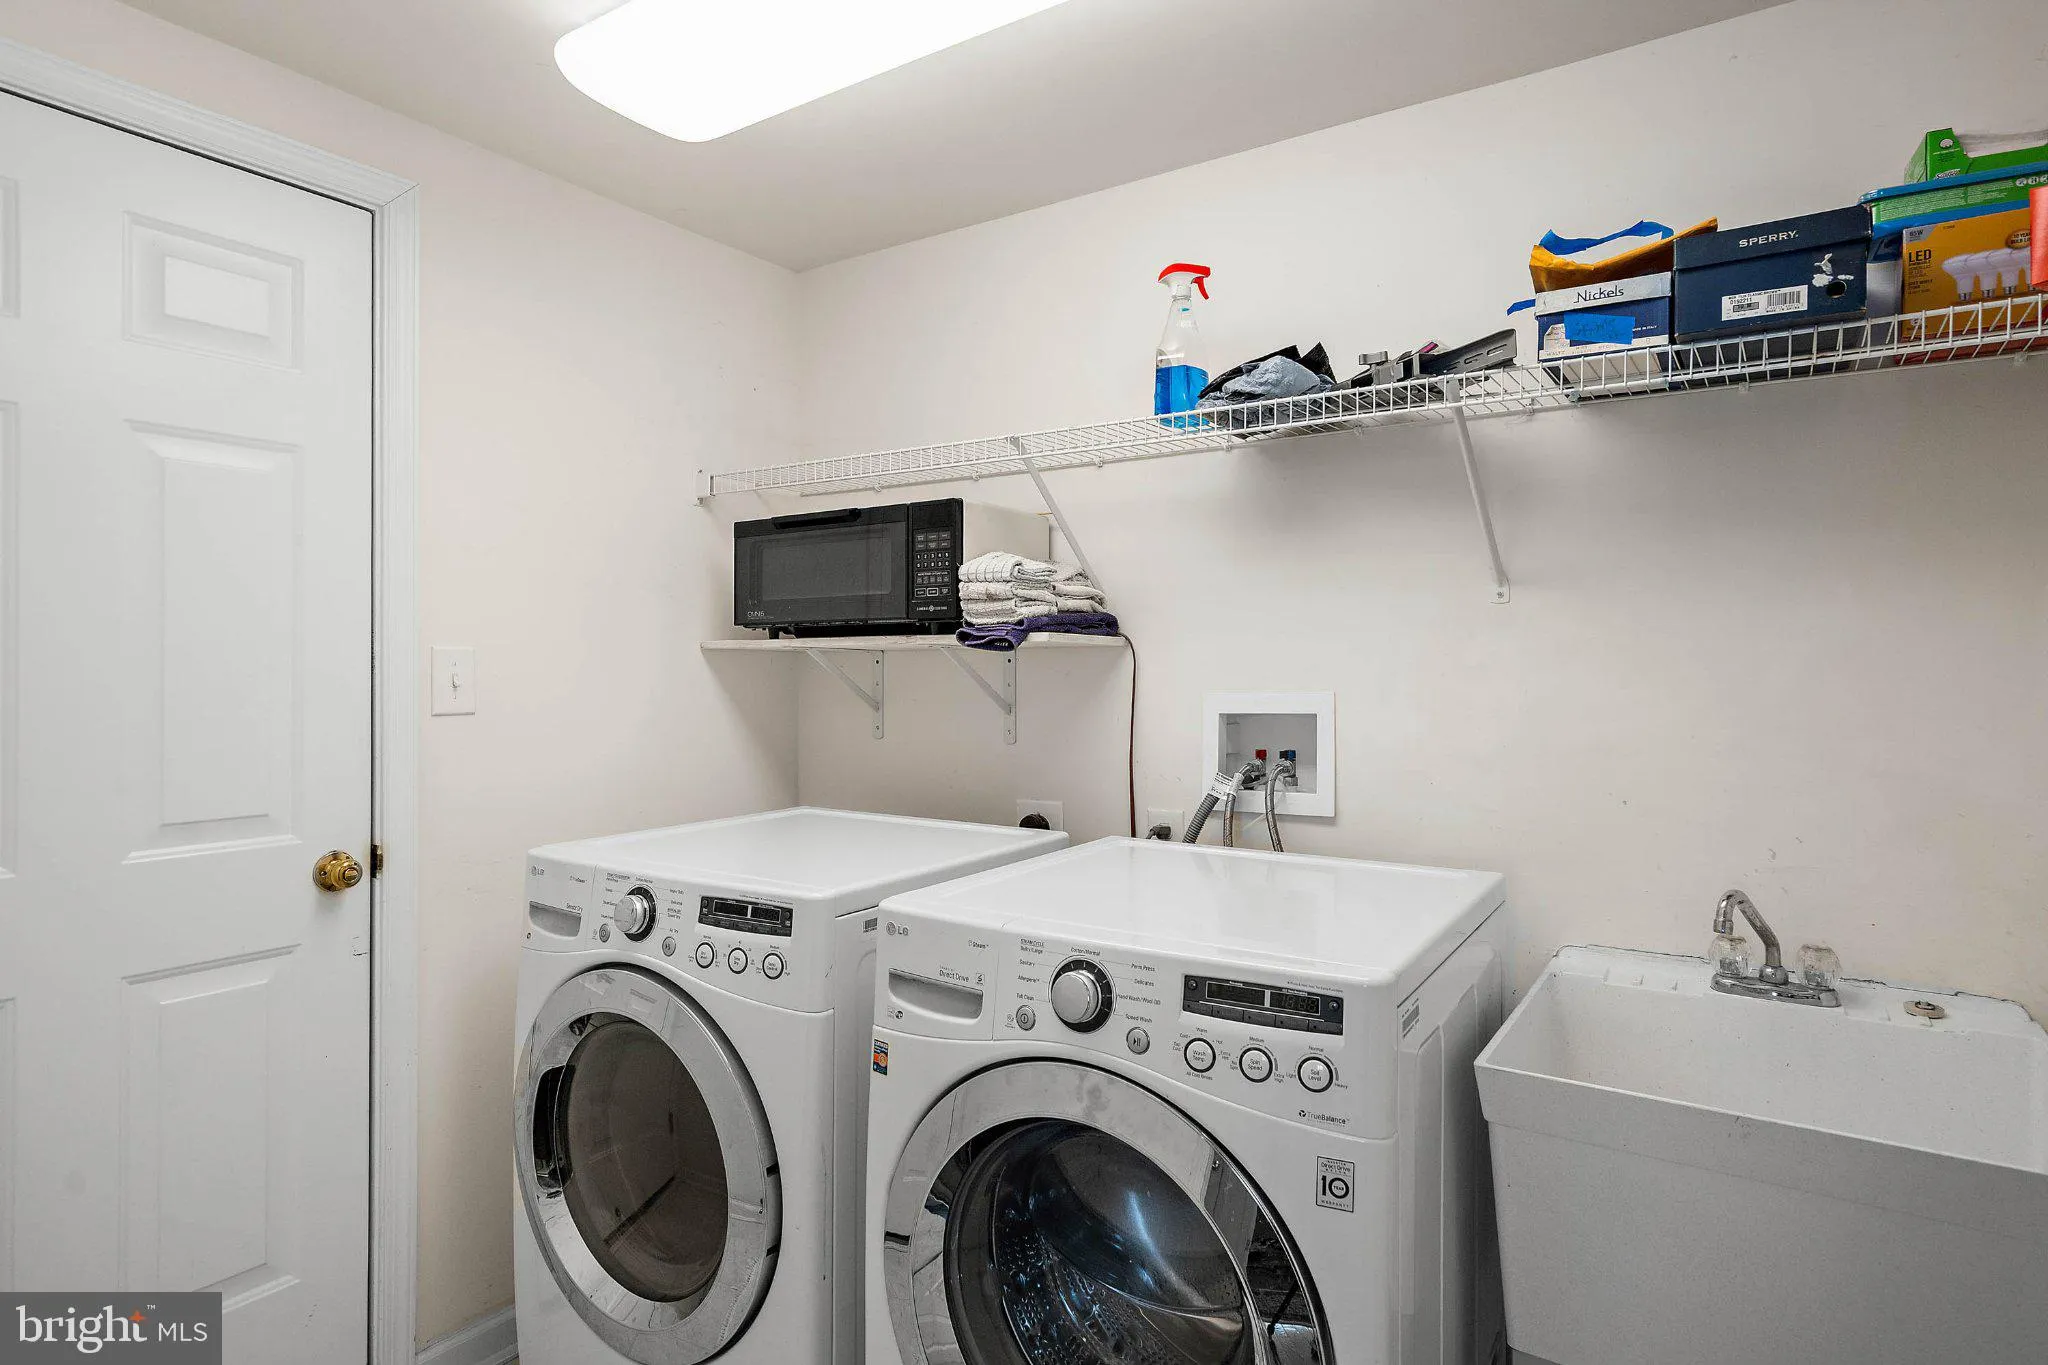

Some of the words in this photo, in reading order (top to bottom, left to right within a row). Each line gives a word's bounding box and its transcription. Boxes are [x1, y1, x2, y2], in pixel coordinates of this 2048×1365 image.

[1908, 248, 1932, 263] LED
[1574, 284, 1625, 303] Nickels
[897, 925, 909, 936] LG
[939, 969, 955, 979] Direct
[955, 972, 970, 983] Drive
[1192, 1049, 1207, 1057] Wash
[1249, 1058, 1261, 1066] Spin
[1247, 1064, 1263, 1072] Speed
[1310, 1068, 1320, 1076] Soil
[1321, 1174, 1350, 1200] 10
